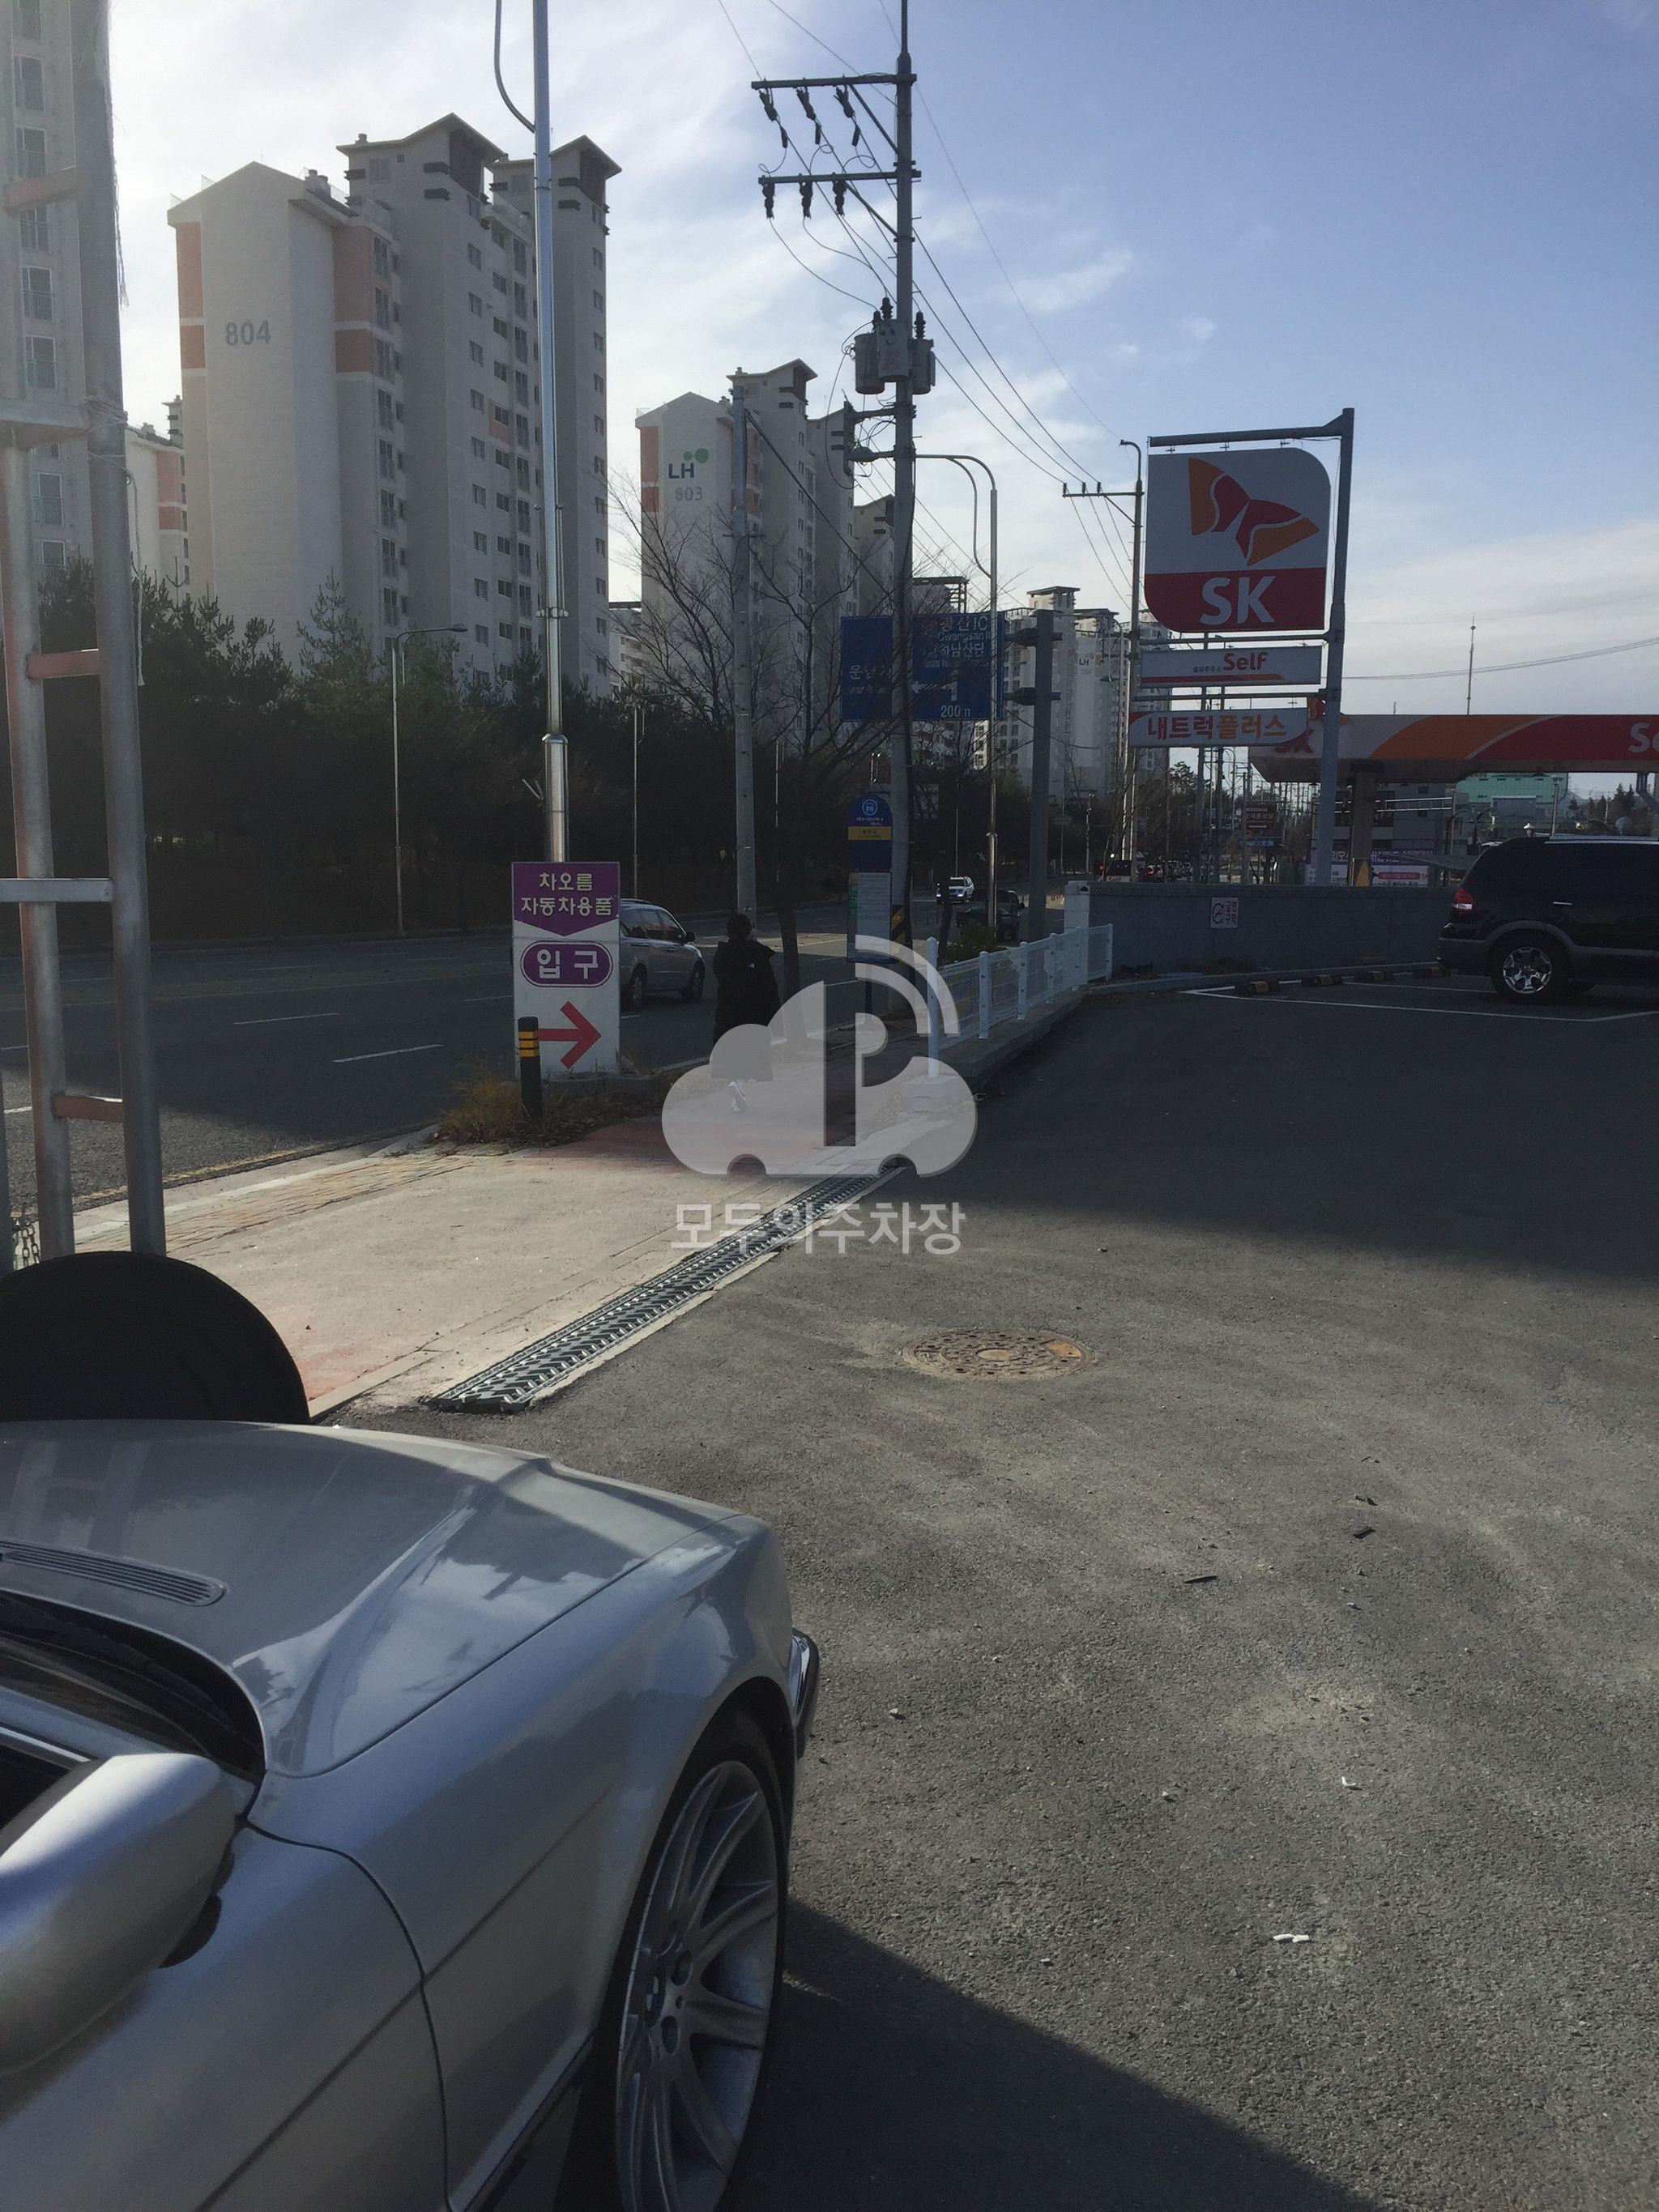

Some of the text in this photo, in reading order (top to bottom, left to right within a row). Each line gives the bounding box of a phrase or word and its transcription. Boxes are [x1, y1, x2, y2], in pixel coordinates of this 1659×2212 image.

[225, 319, 271, 346] 804
[668, 462, 694, 479] LH
[675, 486, 703, 501] 803
[1199, 574, 1277, 625] SK
[1222, 651, 1269, 671] Self
[1146, 714, 1286, 741] 내트럭플러스
[539, 872, 593, 891] 차오름
[521, 897, 612, 916] 자동차용품
[536, 948, 599, 979] 입구
